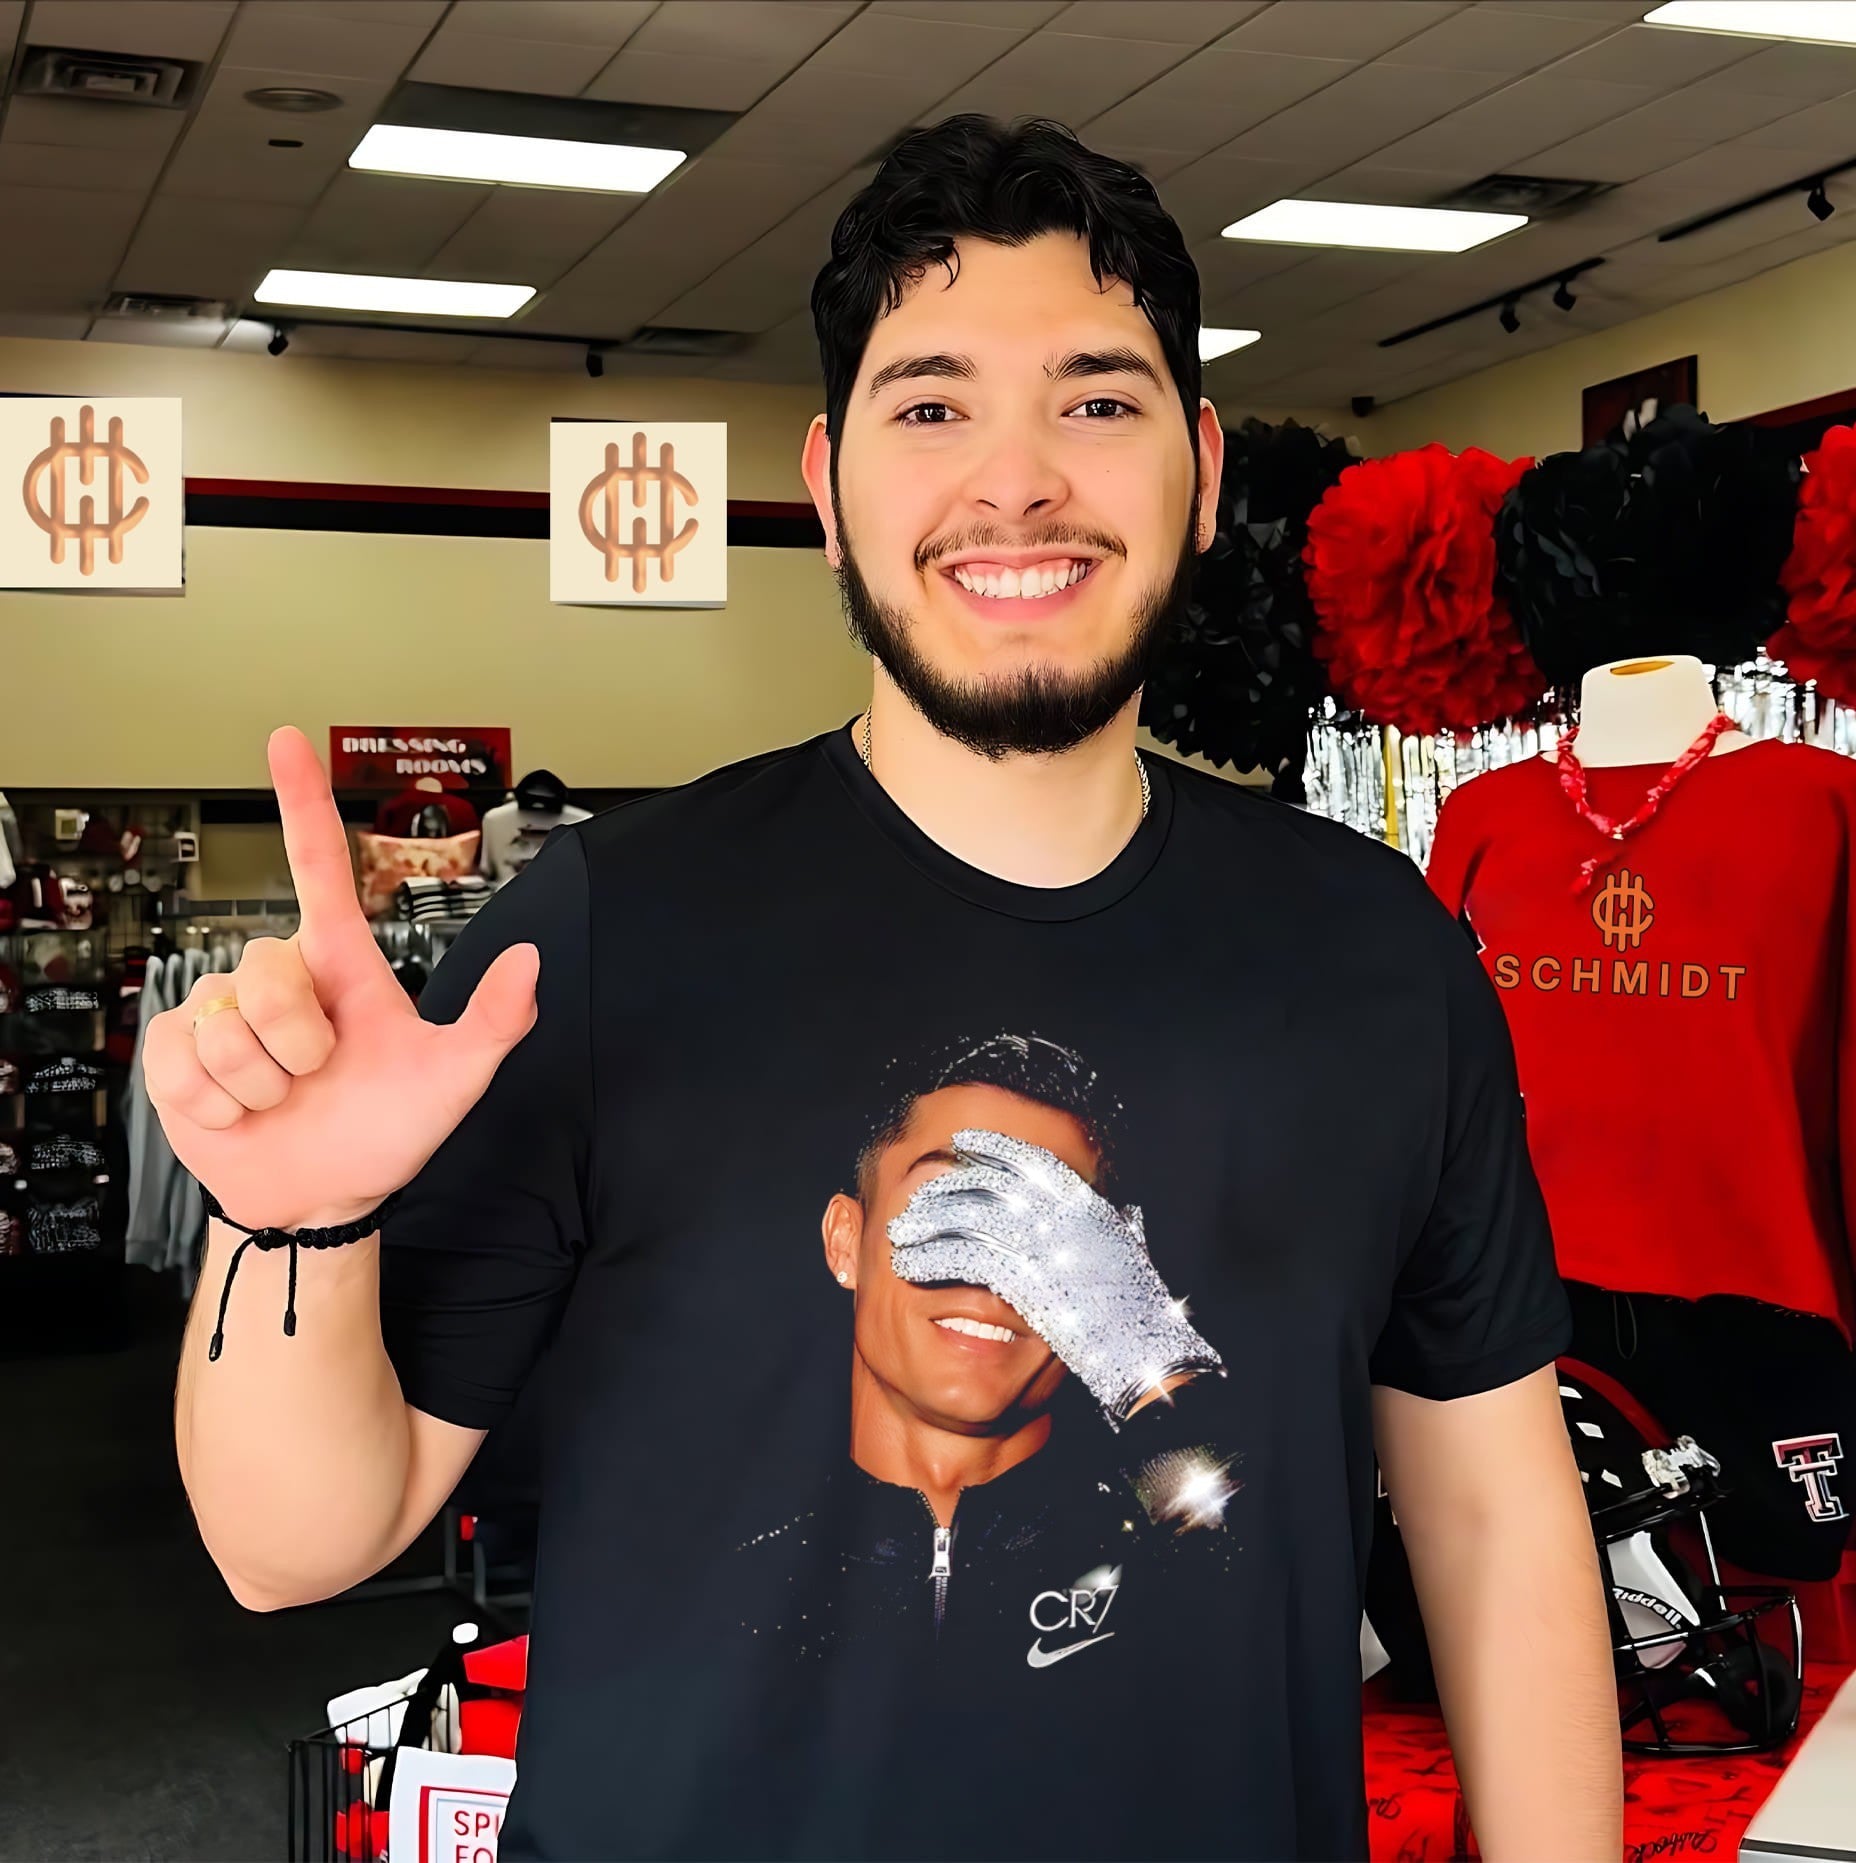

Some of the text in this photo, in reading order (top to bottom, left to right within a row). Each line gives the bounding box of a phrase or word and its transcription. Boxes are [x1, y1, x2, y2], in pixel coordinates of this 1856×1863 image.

[342, 737, 467, 754] DRESSING
[396, 758, 487, 775] ROOMS
[1494, 953, 1747, 1001] SCHMIDT
[1029, 1584, 1119, 1634] CR7
